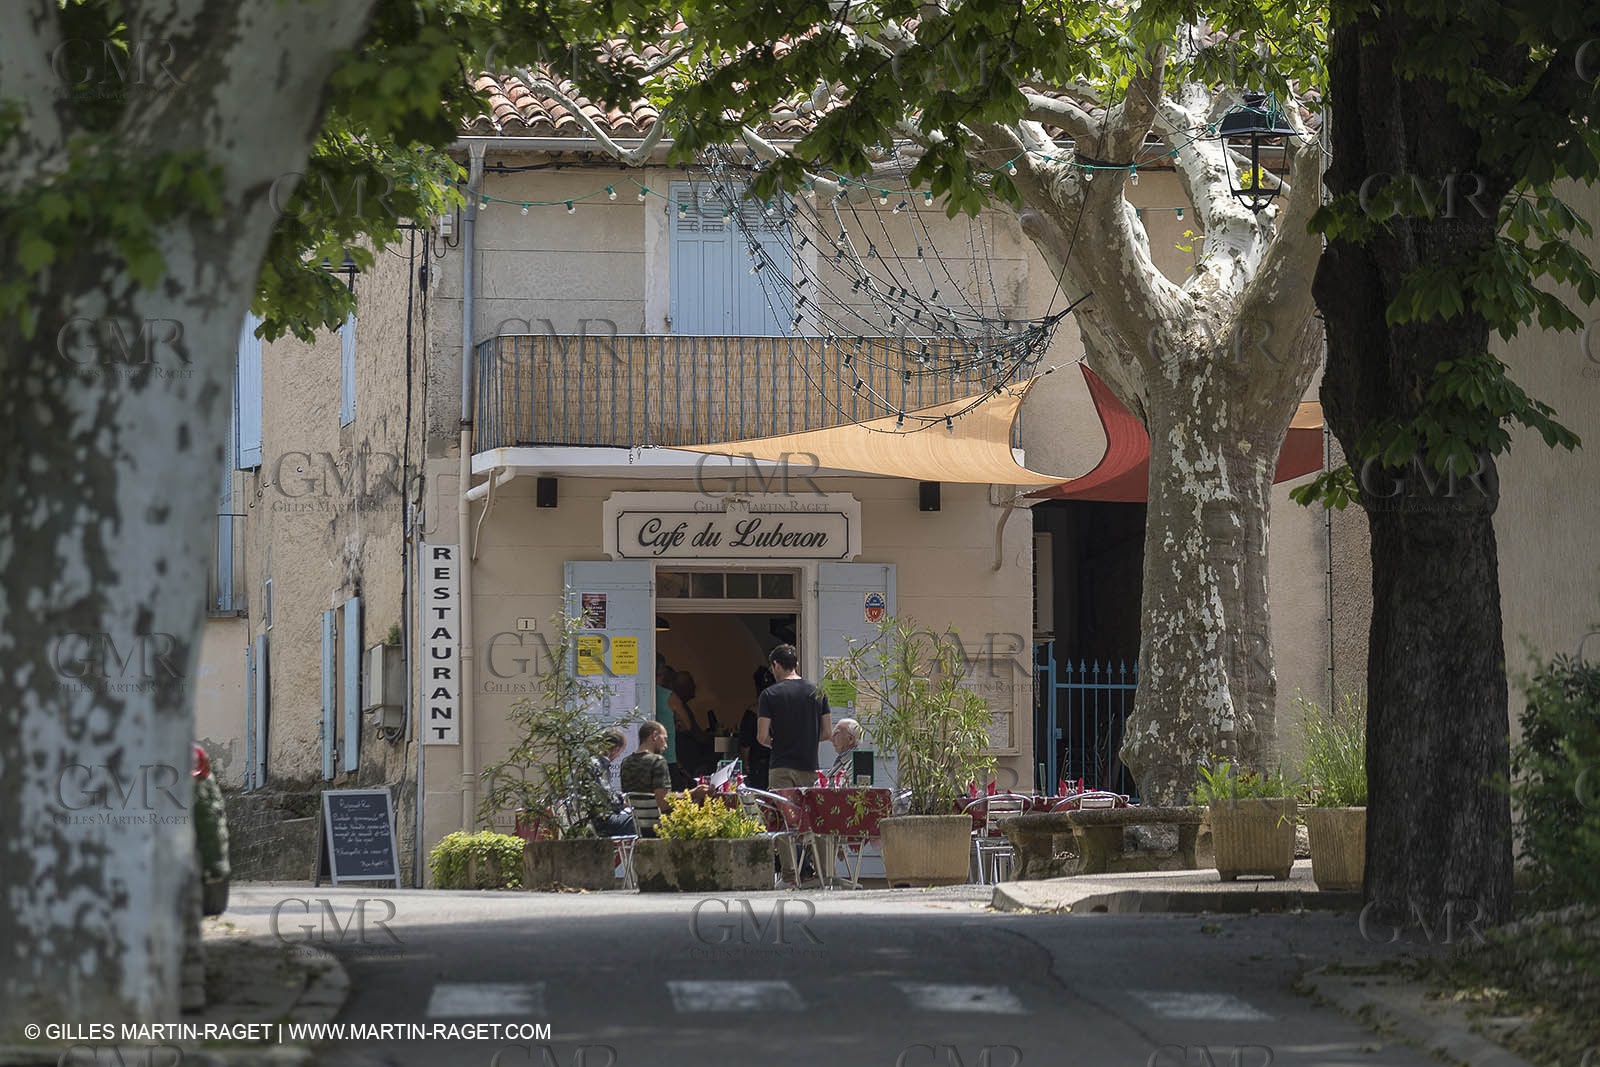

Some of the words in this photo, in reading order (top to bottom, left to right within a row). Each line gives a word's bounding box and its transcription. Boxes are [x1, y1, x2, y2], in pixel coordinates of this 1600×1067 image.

[637, 517, 687, 555] Café
[692, 521, 722, 547] du
[729, 518, 828, 548] Luberon
[430, 547, 452, 740] RESTAURANT
